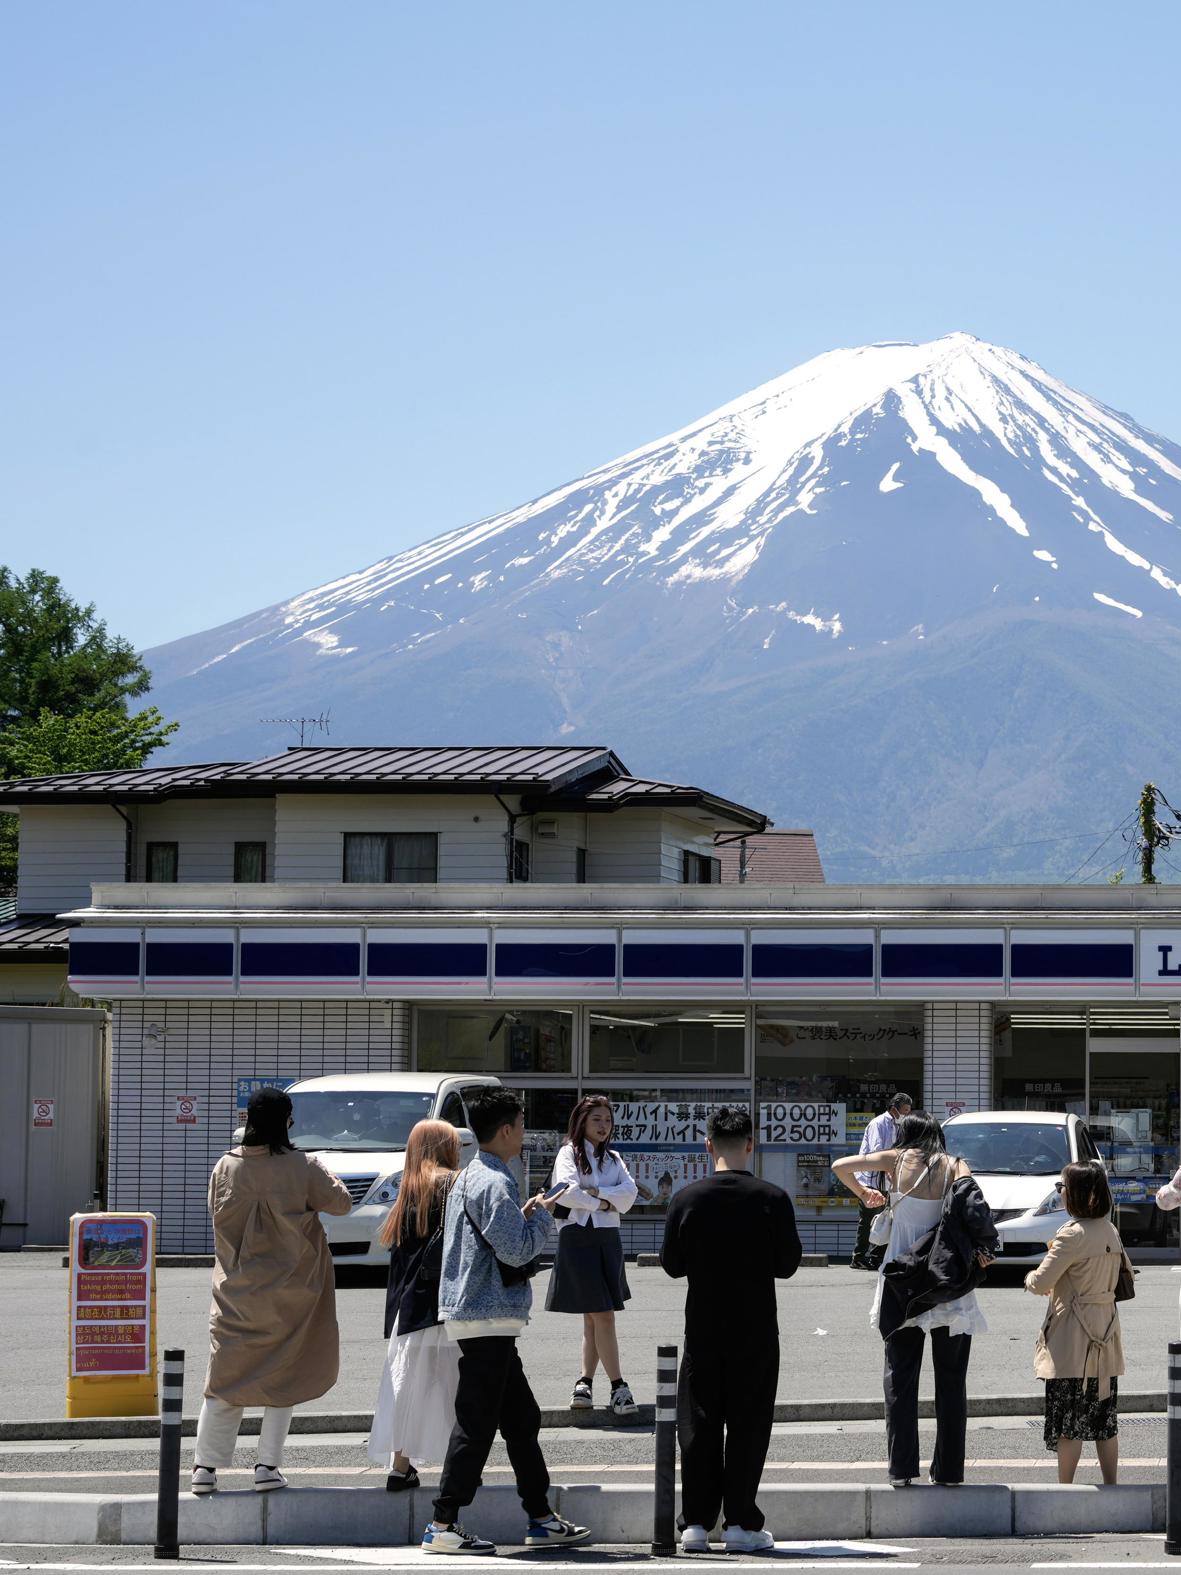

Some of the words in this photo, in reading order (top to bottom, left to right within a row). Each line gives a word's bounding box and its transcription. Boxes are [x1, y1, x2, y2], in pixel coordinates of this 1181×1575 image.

[796, 1025, 921, 1042] ご褒美スティックケーキ
[859, 1083, 897, 1094] 無印良品
[1024, 1082, 1063, 1093] 無印良品
[81, 1283, 102, 1291] taking
[102, 1283, 126, 1291] photos
